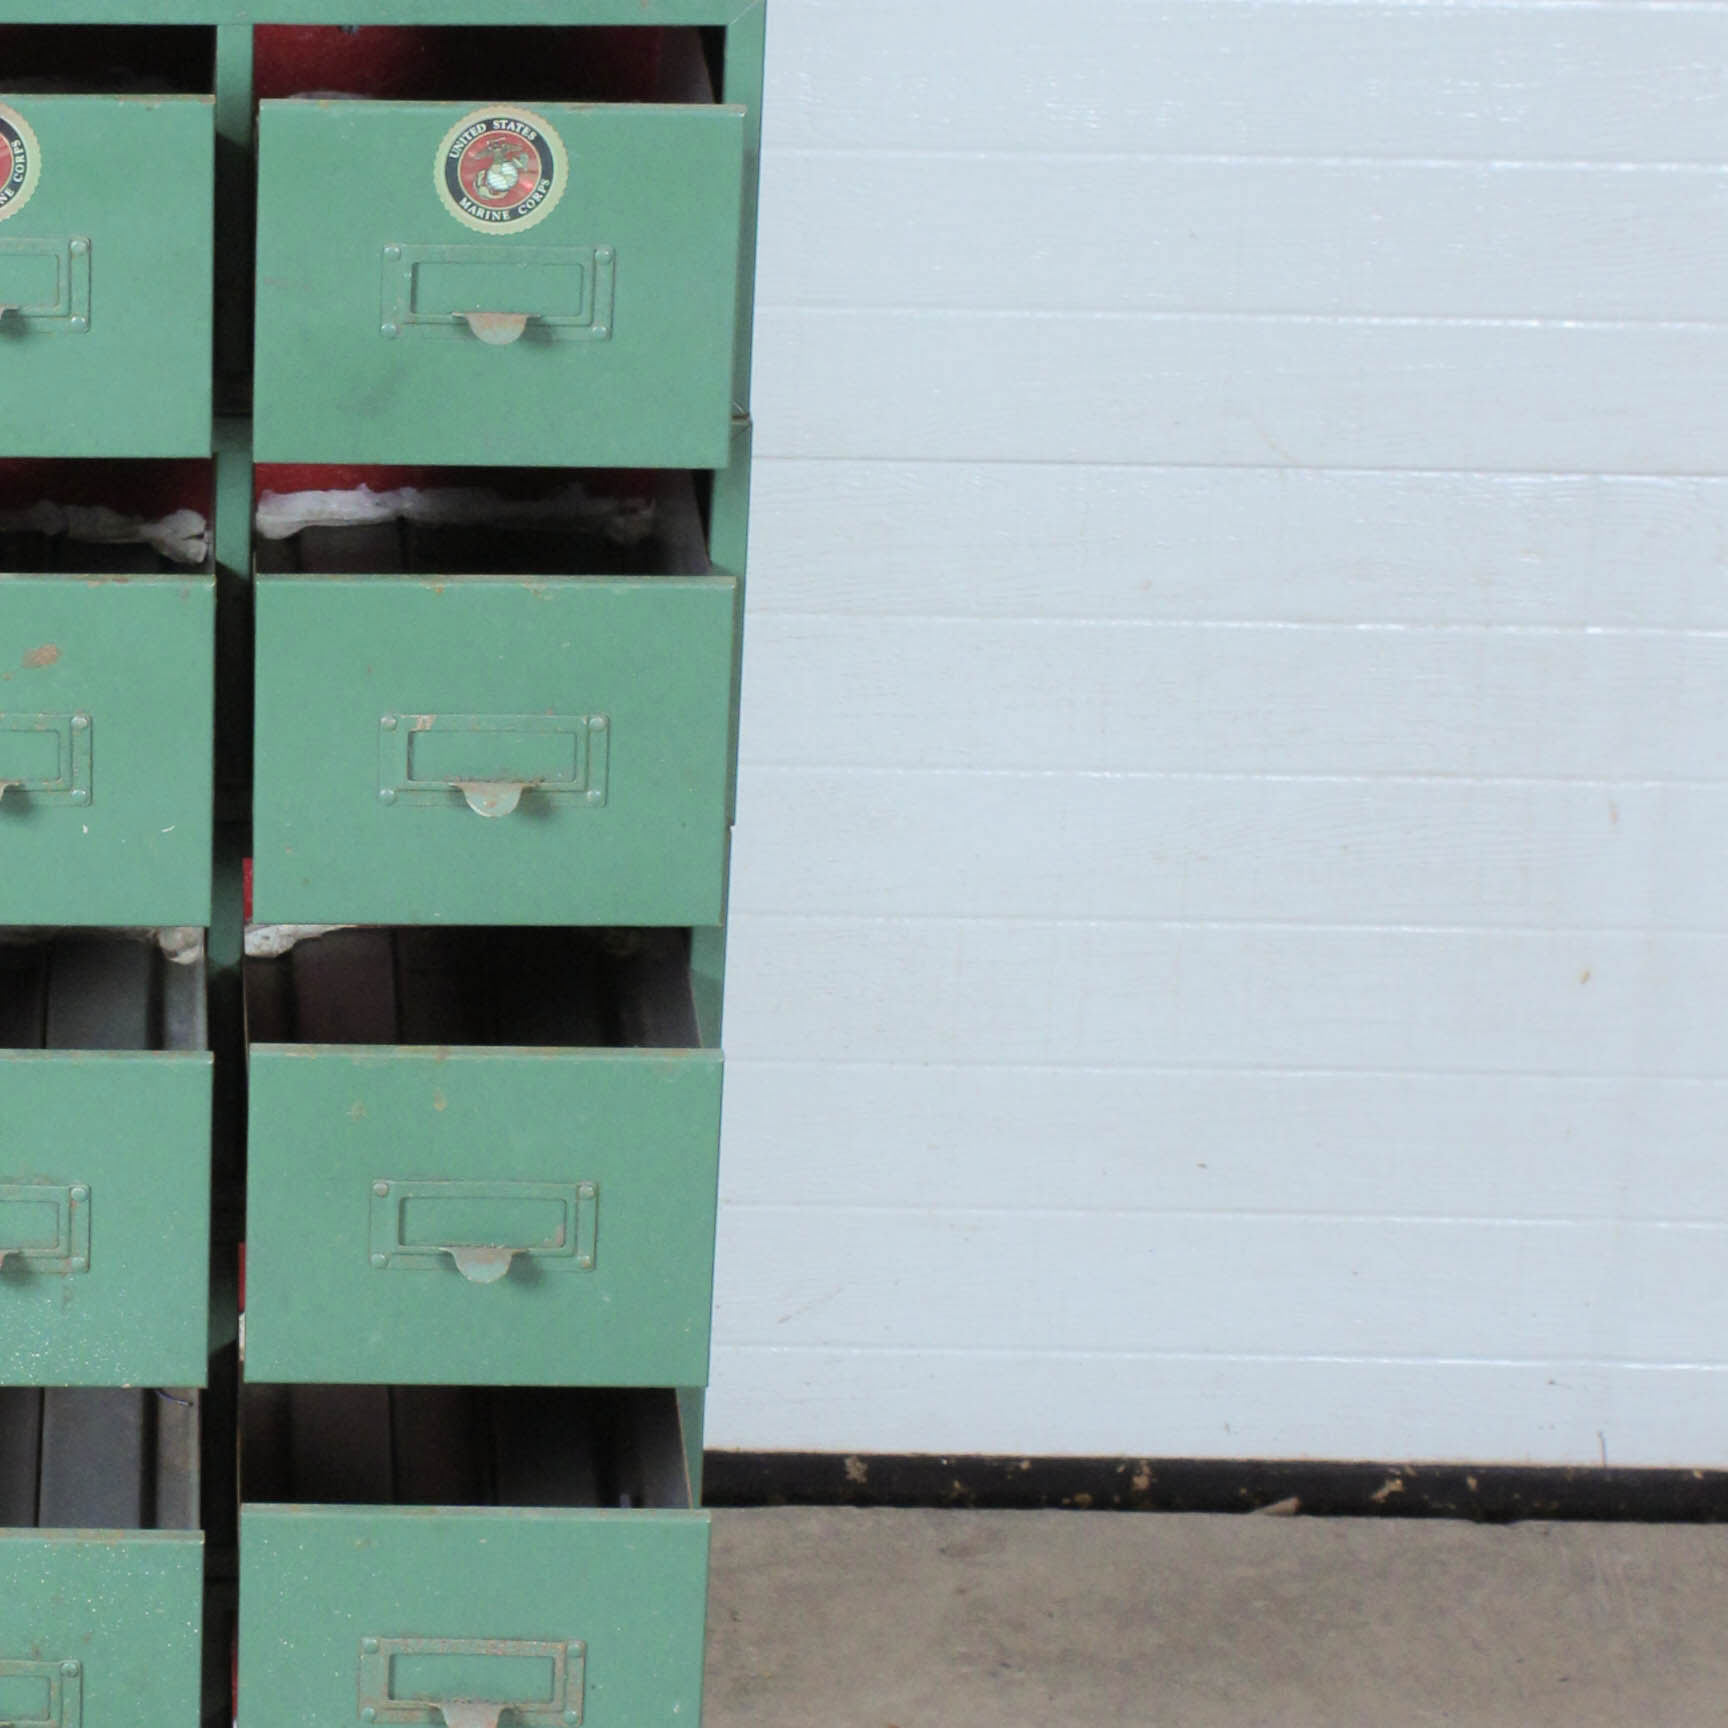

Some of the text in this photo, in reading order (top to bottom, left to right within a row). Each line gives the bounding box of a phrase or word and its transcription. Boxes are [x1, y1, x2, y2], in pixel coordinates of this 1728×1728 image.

[12, 139, 26, 183] CORPS
[449, 120, 537, 159] UNITED STATES
[459, 178, 550, 221] MARINE CORPS
